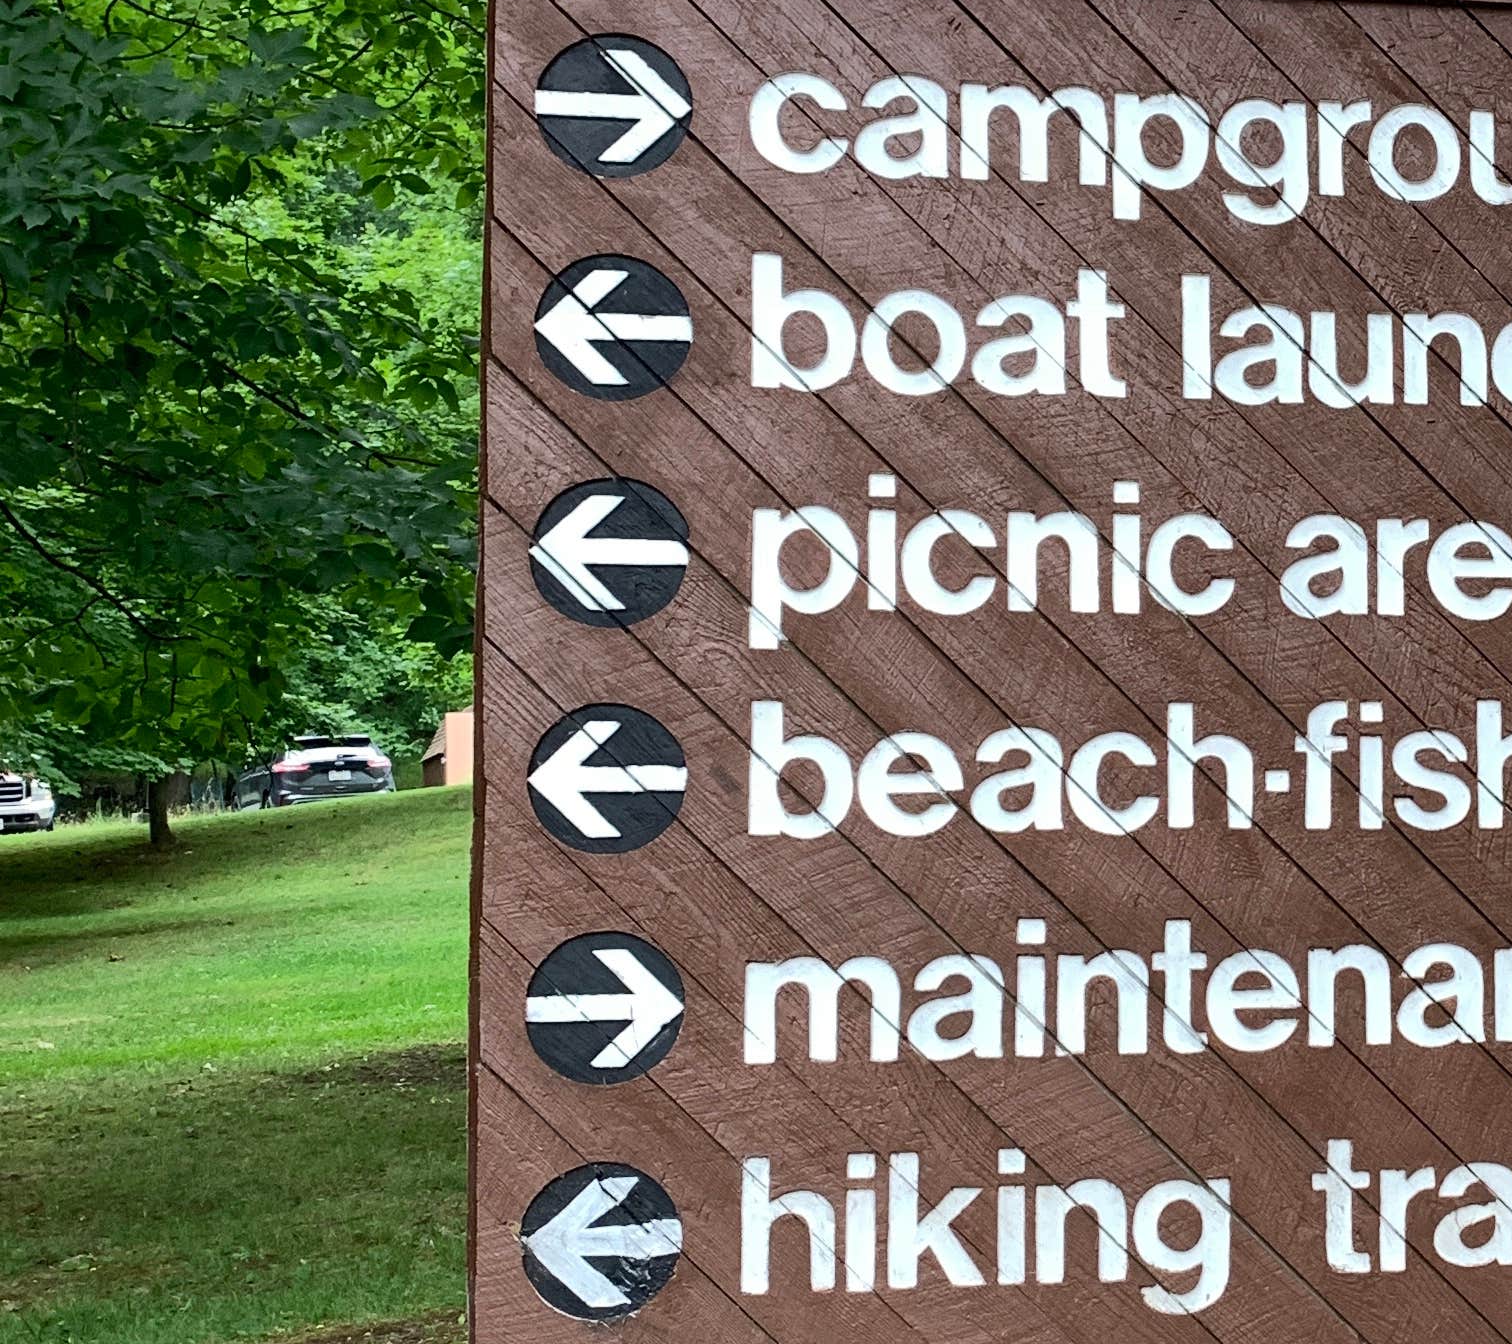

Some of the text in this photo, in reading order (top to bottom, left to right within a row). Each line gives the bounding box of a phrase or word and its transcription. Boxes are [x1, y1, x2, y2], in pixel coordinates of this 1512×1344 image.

[749, 251, 1128, 400] boat
[744, 472, 1237, 652] picnic
[739, 1146, 1234, 1316] hiking
